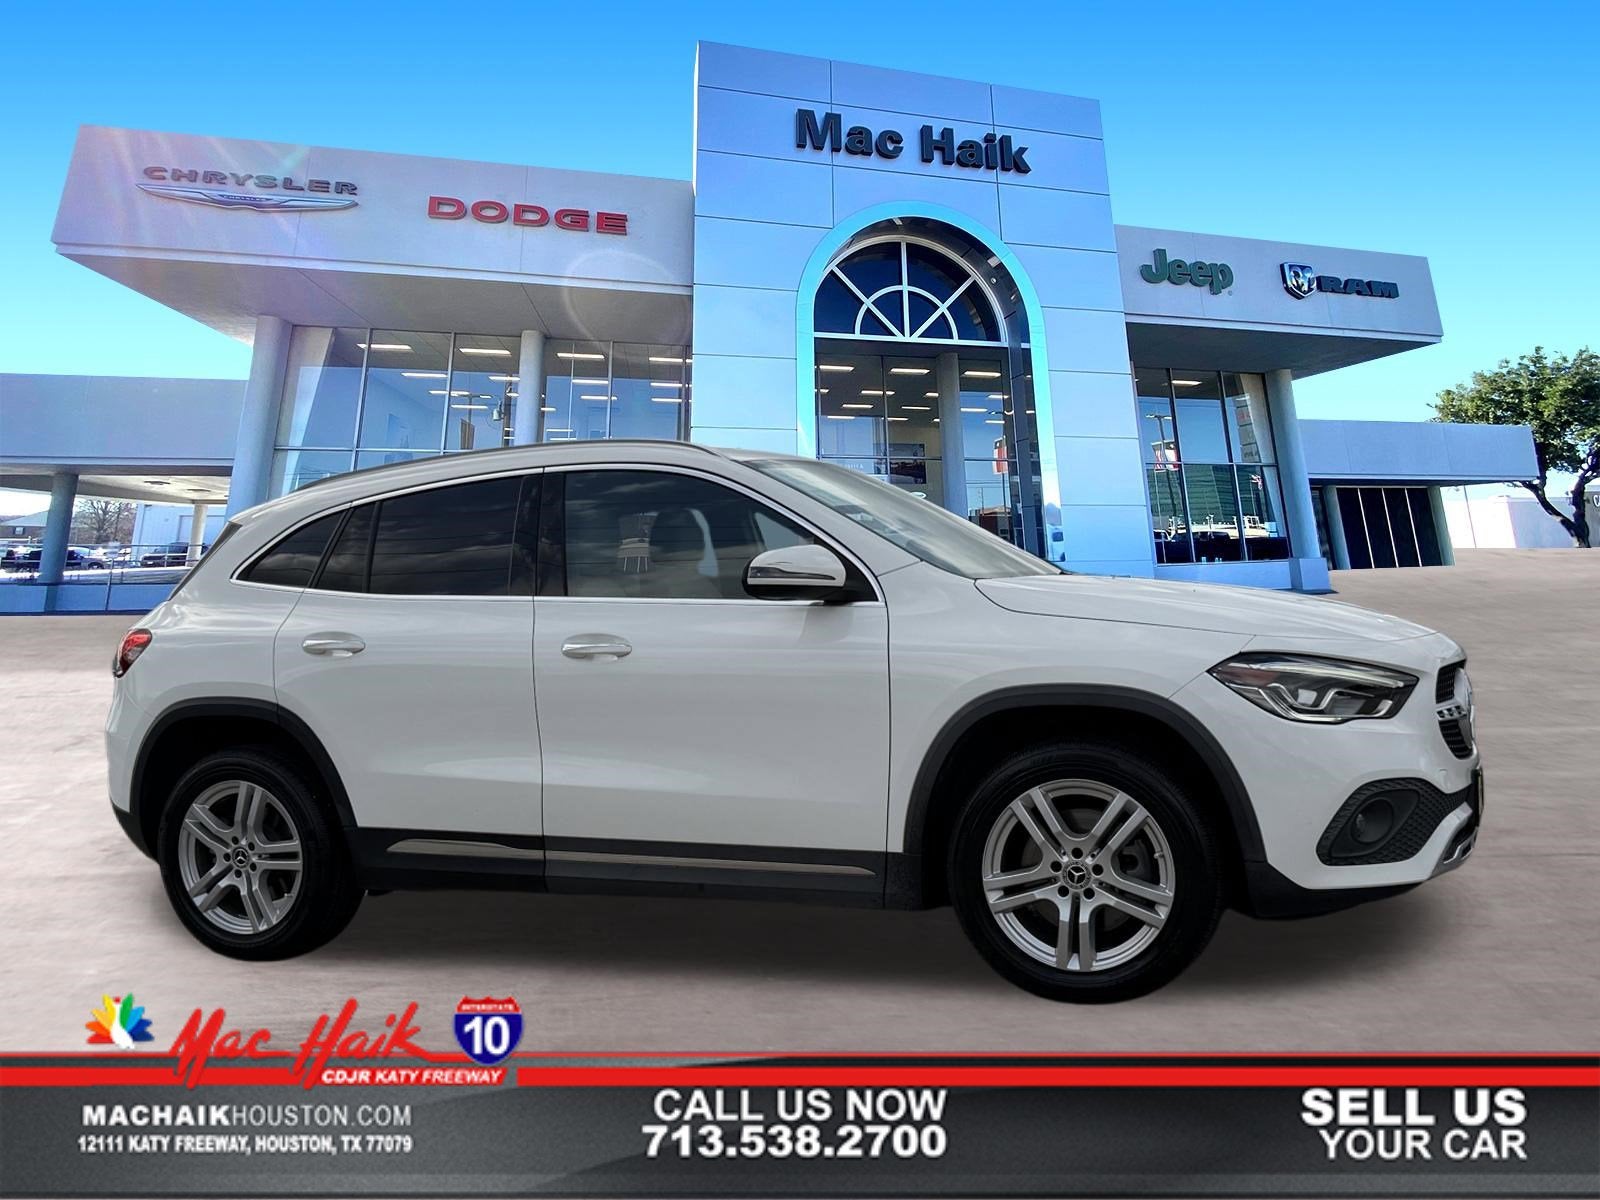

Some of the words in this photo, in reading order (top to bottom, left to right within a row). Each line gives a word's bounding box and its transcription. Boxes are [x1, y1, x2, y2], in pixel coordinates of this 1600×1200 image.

[795, 108, 904, 160] Mac
[919, 124, 1032, 174] Haik
[143, 166, 358, 195] CHRYSLER
[428, 195, 628, 236] DODGE
[1140, 249, 1234, 295] Jeep
[1316, 275, 1399, 298] RAM
